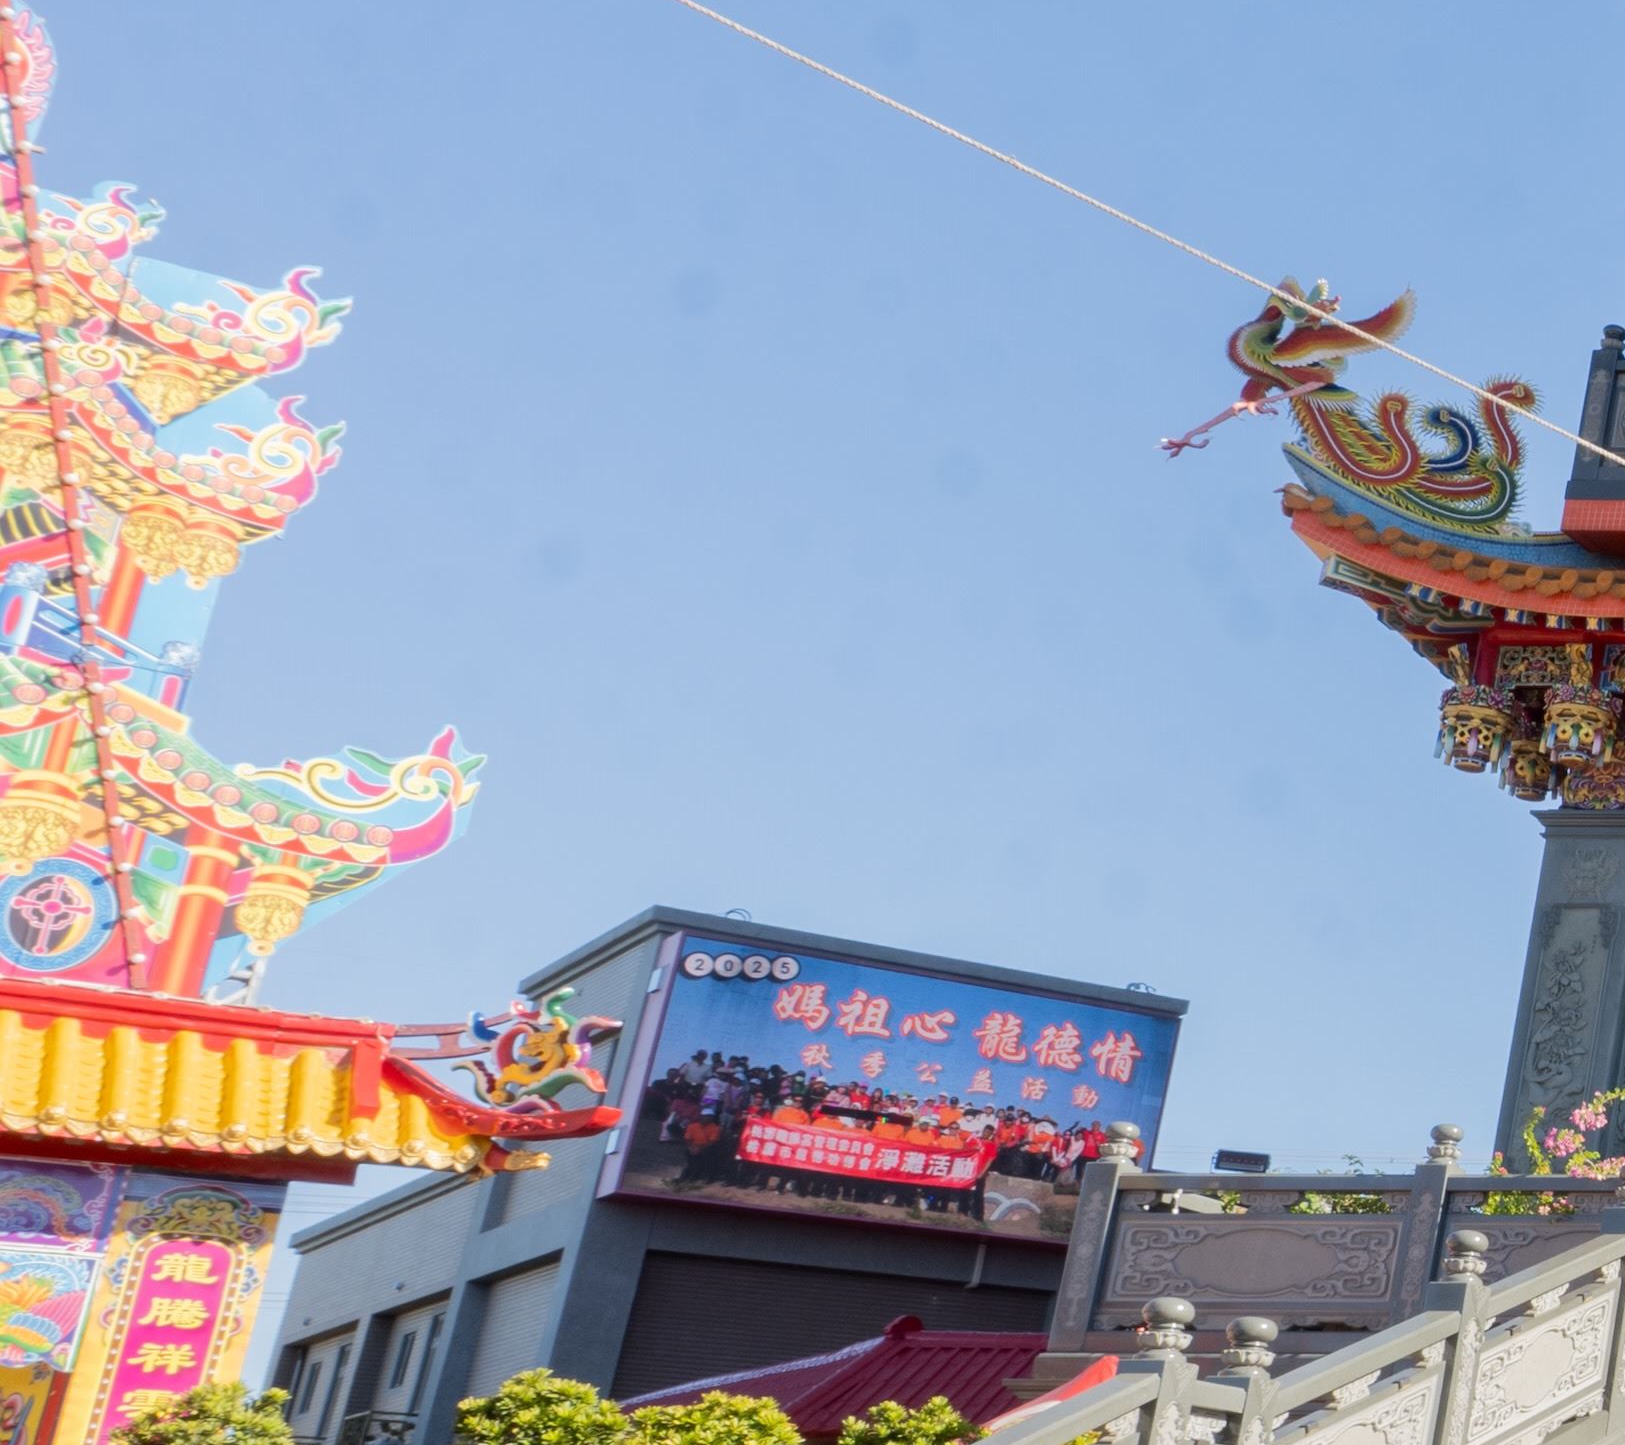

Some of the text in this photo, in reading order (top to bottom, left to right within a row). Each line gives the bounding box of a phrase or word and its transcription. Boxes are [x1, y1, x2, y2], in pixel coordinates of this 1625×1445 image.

[692, 956, 793, 978] 2025
[773, 983, 1143, 1085] 媽祖心 龍德情
[802, 1043, 1099, 1111] 秋季公益活動
[876, 1148, 978, 1180] 淨灘活動
